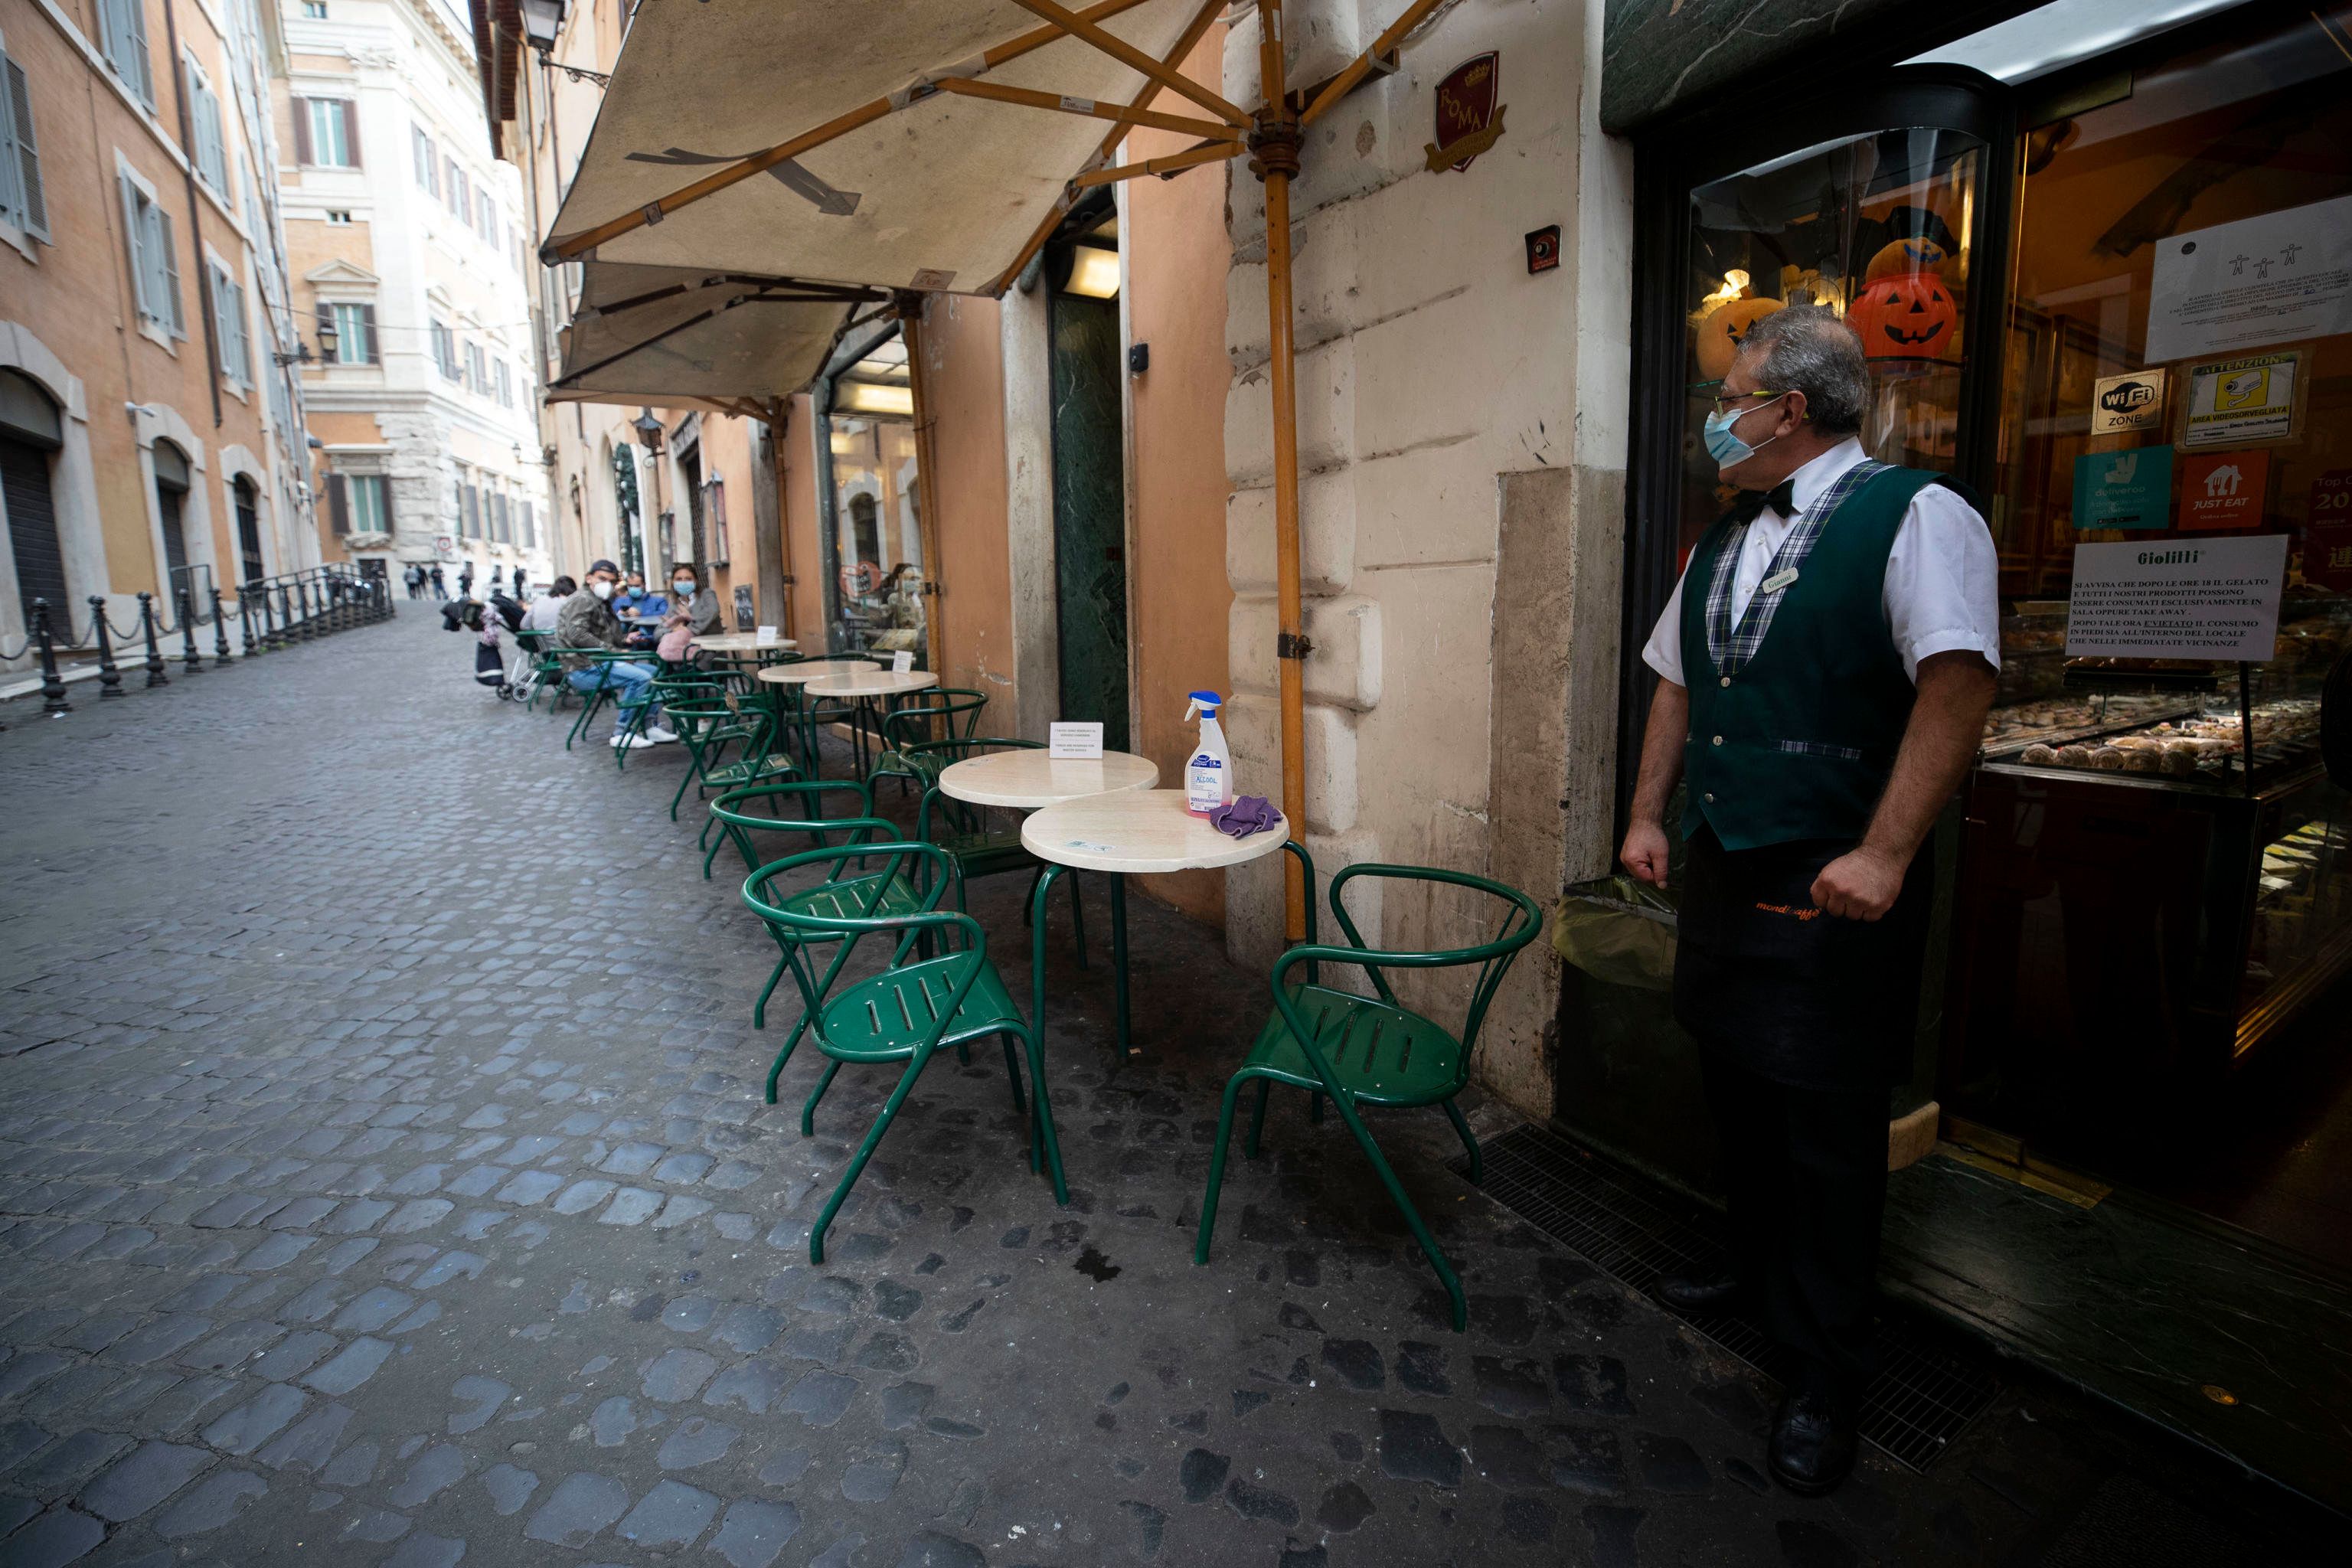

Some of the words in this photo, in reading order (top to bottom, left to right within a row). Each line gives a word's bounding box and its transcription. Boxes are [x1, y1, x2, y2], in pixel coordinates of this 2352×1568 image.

[1441, 87, 1482, 131] ROMA
[2204, 355, 2287, 373] ATTENZION
[2109, 414, 2143, 426] ZONE
[2192, 415, 2211, 424] AREA
[2212, 407, 2287, 422] VIDEOSORVEGLIATA
[2317, 478, 2341, 488] Top
[2095, 486, 2146, 497] deliveroo
[2193, 498, 2223, 511] JUST
[2224, 497, 2249, 508] EAT
[1769, 573, 1792, 589] Gianni
